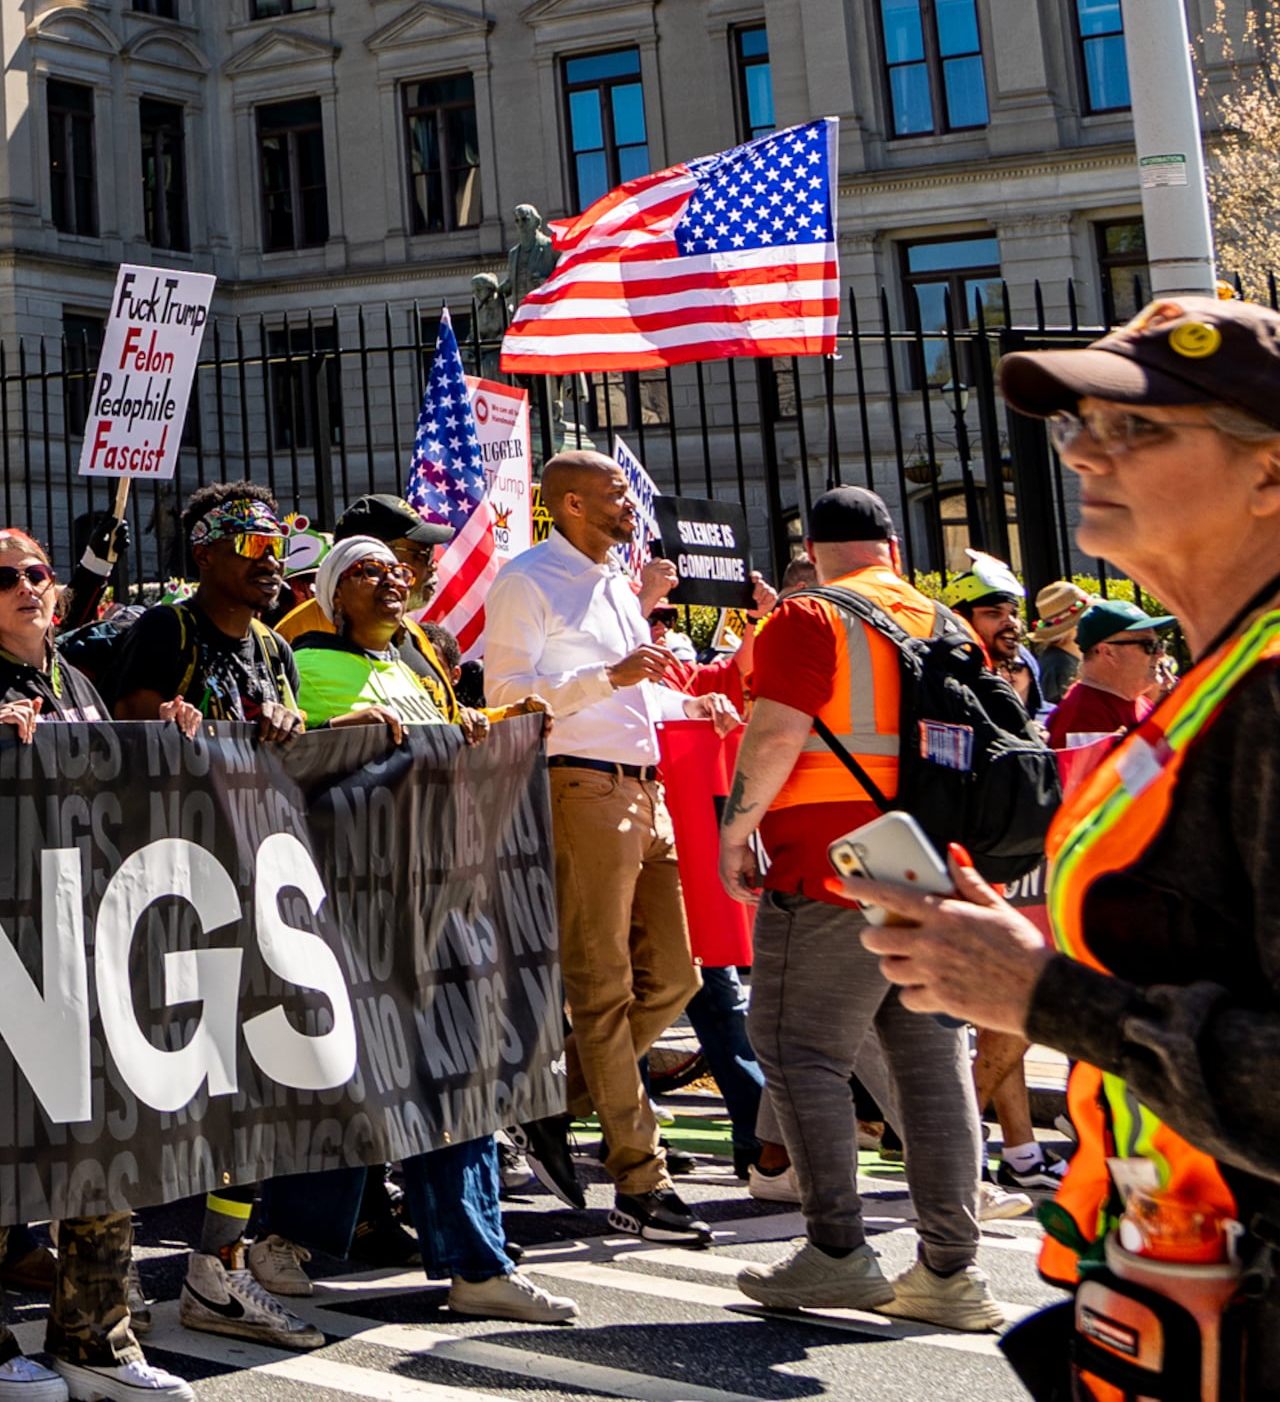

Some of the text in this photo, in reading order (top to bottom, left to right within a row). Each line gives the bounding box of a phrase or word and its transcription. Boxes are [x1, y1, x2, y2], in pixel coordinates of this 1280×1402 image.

[115, 273, 208, 336] Fuck Trump
[118, 327, 175, 374] Felon
[94, 372, 176, 433] Pedophile
[89, 420, 169, 473] Fascist
[494, 528, 509, 544] NO
[677, 520, 720, 548] SILENCE
[719, 524, 736, 549] IS
[677, 553, 747, 583] COMPLIANCE
[329, 785, 396, 879] NO
[356, 992, 412, 1095] NO
[414, 969, 524, 1081] KINGS
